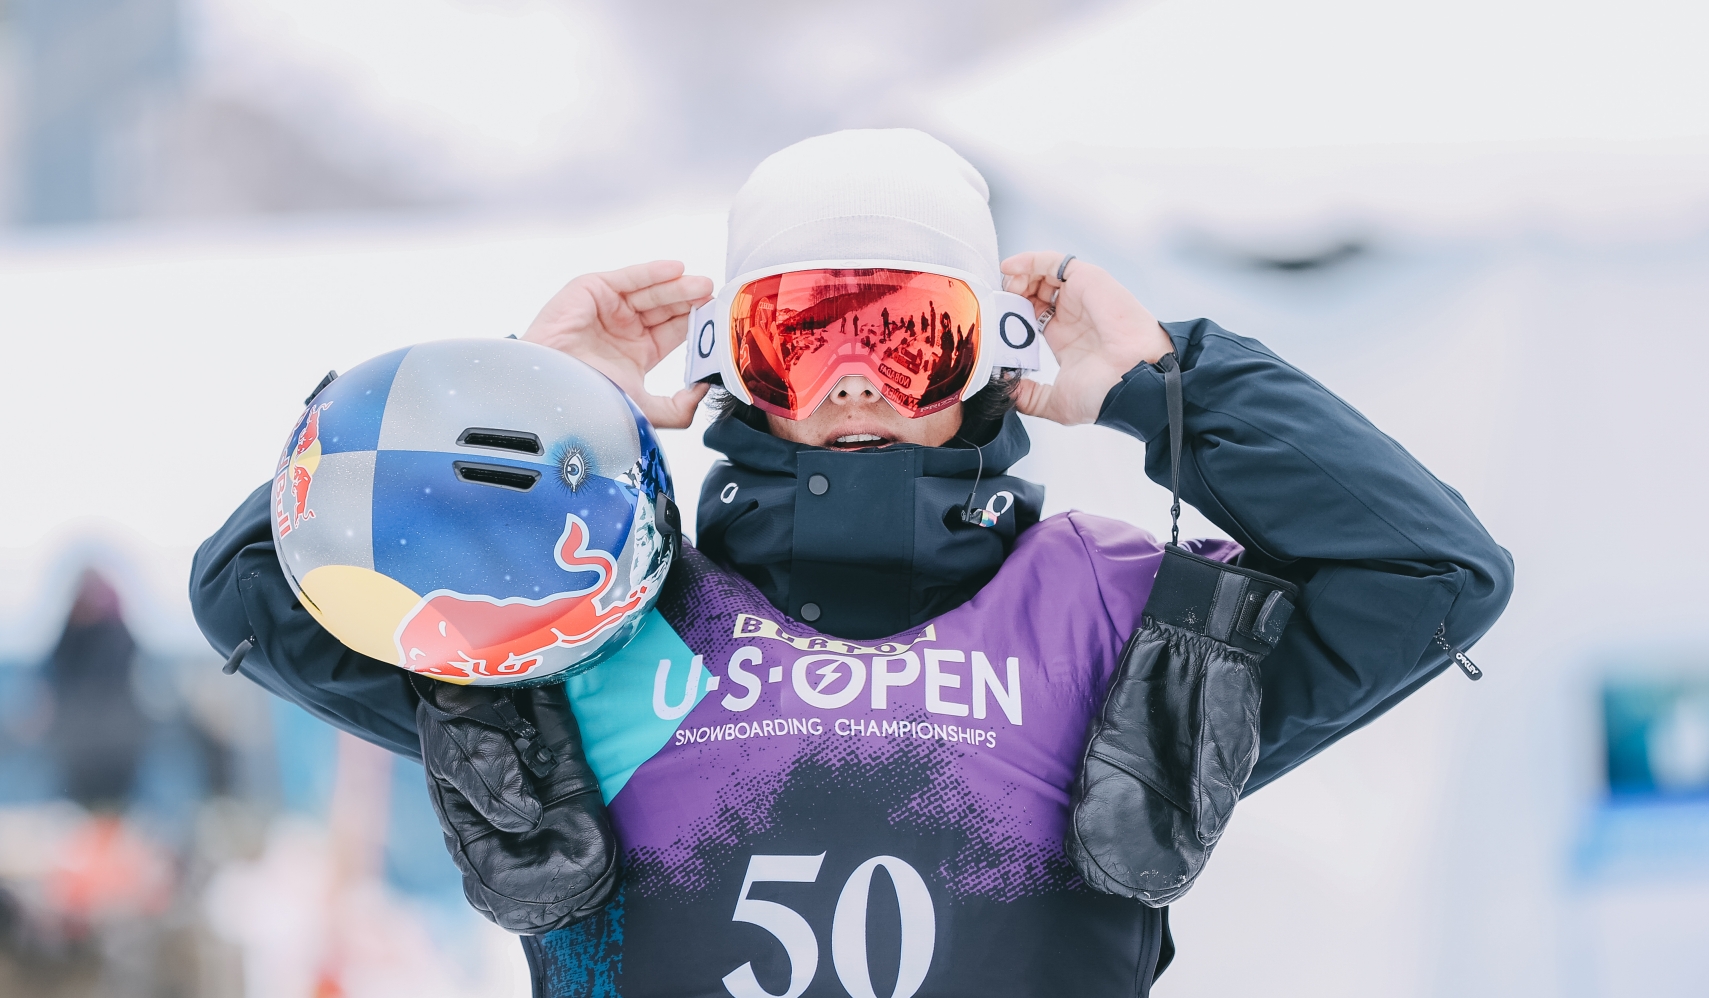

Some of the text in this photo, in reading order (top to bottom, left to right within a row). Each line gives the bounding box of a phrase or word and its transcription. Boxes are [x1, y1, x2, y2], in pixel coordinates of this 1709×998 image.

[675, 718, 997, 749] SNOWBOARDING CHAMPIONSHIPS
[721, 850, 936, 998] 50
